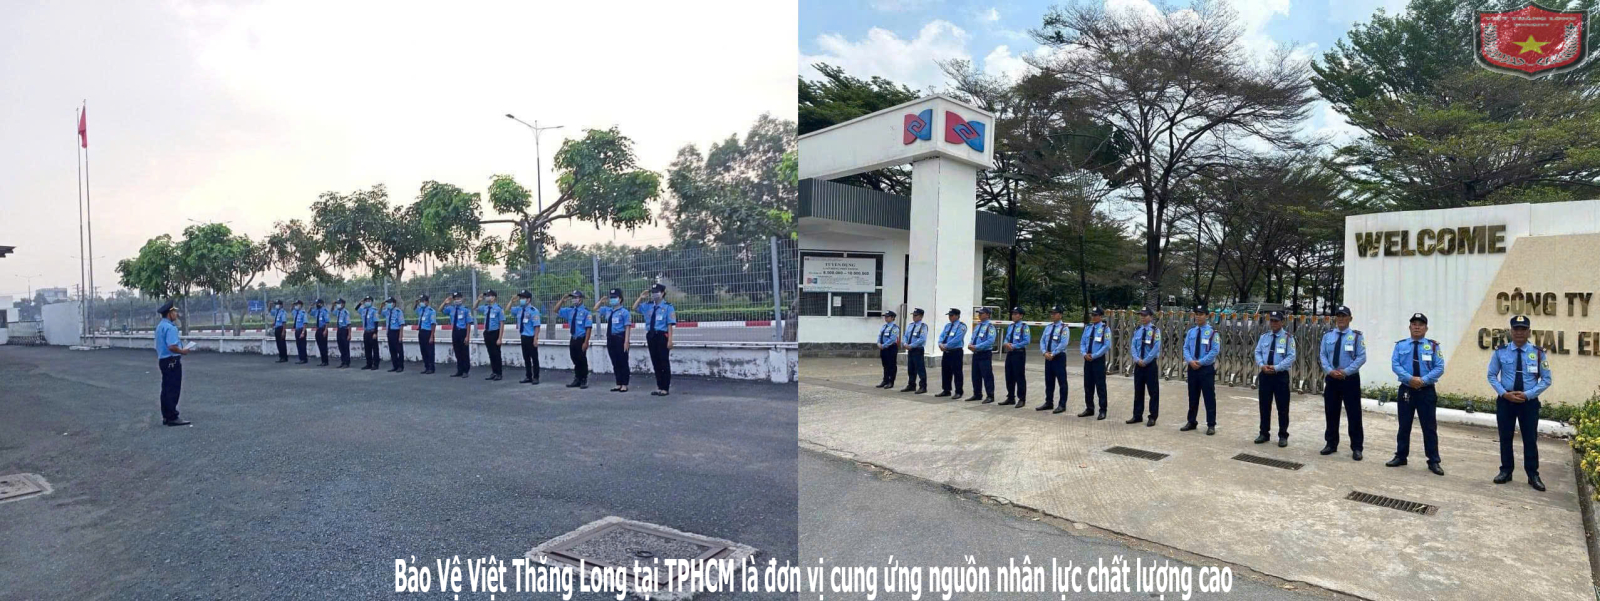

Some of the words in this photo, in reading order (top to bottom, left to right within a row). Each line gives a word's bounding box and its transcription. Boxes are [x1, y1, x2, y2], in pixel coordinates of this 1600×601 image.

[1355, 224, 1506, 258] WELCOME
[1496, 287, 1557, 316] CÔNG
[1565, 292, 1593, 317] TY
